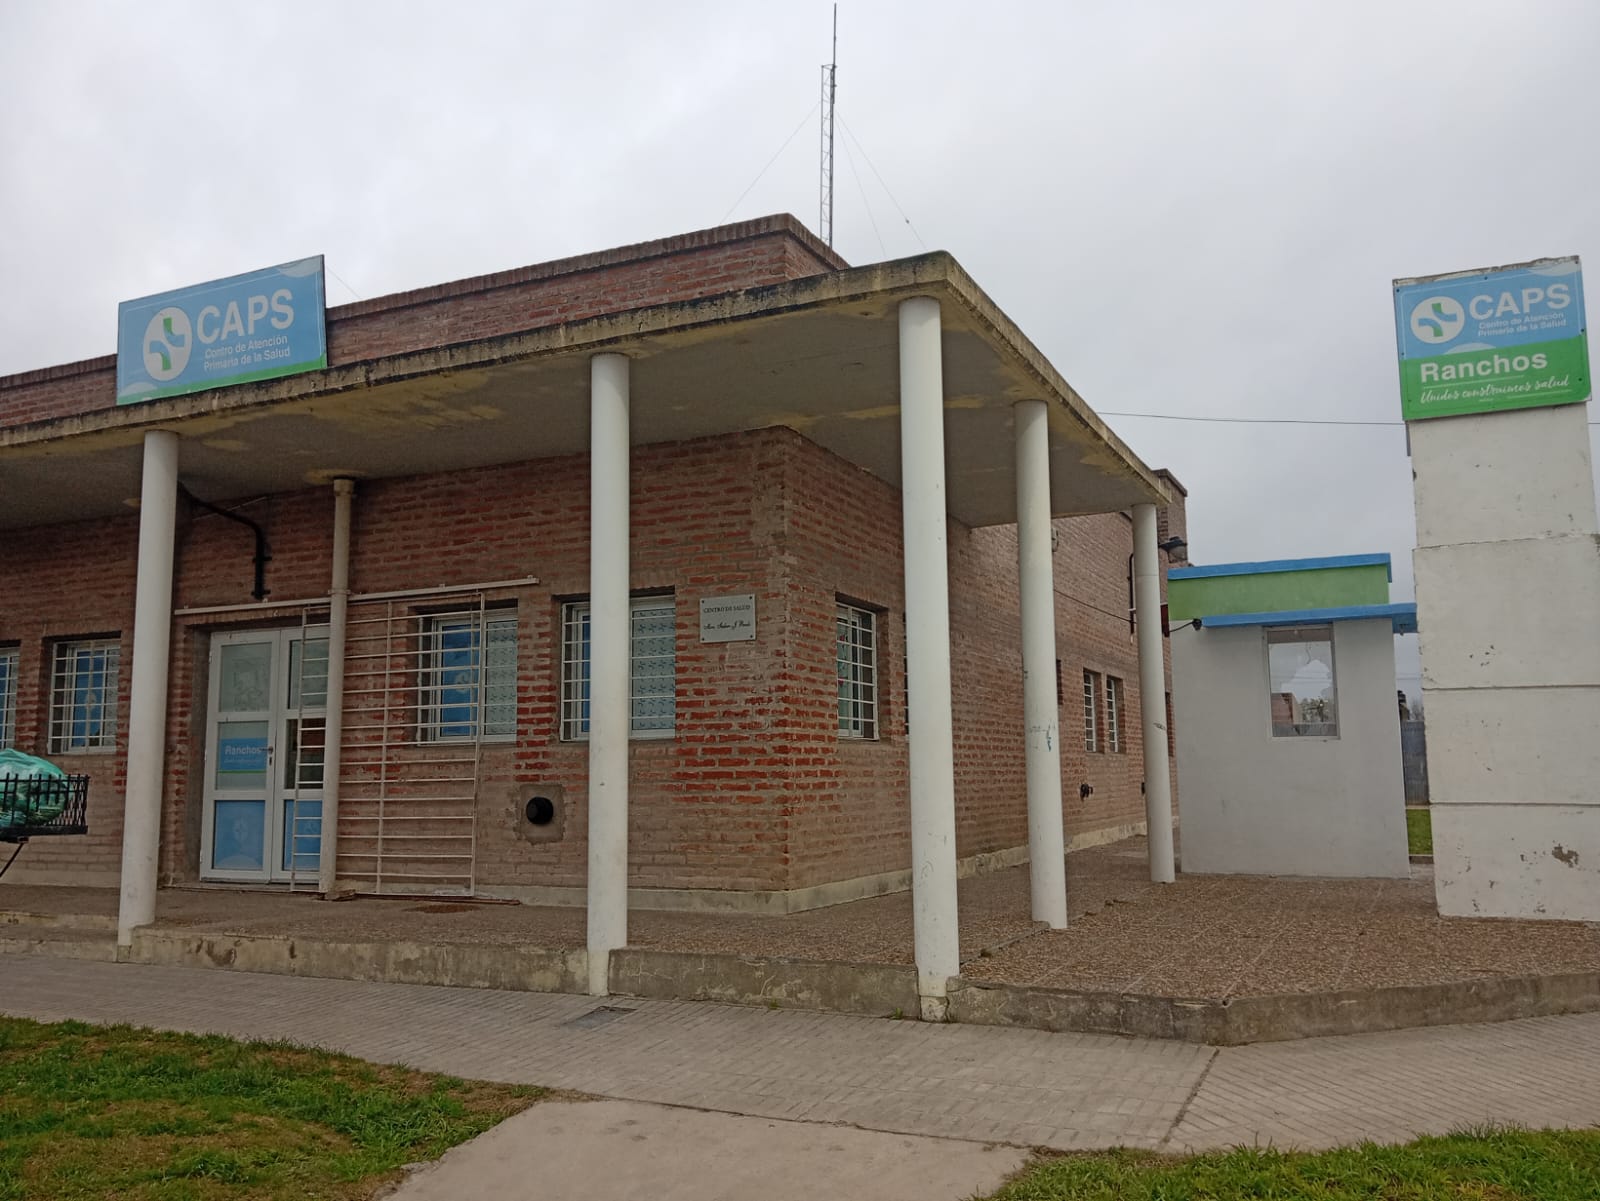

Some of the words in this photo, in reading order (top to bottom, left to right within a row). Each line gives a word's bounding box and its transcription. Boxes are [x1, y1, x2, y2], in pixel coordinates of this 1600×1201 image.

[1469, 284, 1570, 320] CAPS
[197, 289, 294, 344] CAPS
[1478, 326, 1514, 337] Primaria
[1516, 323, 1528, 333] de
[1530, 321, 1538, 330] la
[1540, 318, 1567, 328] Salud
[1479, 320, 1509, 330] Centro
[1511, 317, 1522, 325] de
[1524, 312, 1564, 322] Atención
[204, 357, 239, 371] Primaria
[241, 354, 252, 365] de
[254, 351, 262, 362] la
[264, 345, 290, 360] Salud
[205, 346, 233, 359] Centro
[235, 342, 246, 353] de
[248, 334, 288, 350] Atención
[1420, 353, 1548, 382] Ranchos
[1534, 374, 1570, 391] salud
